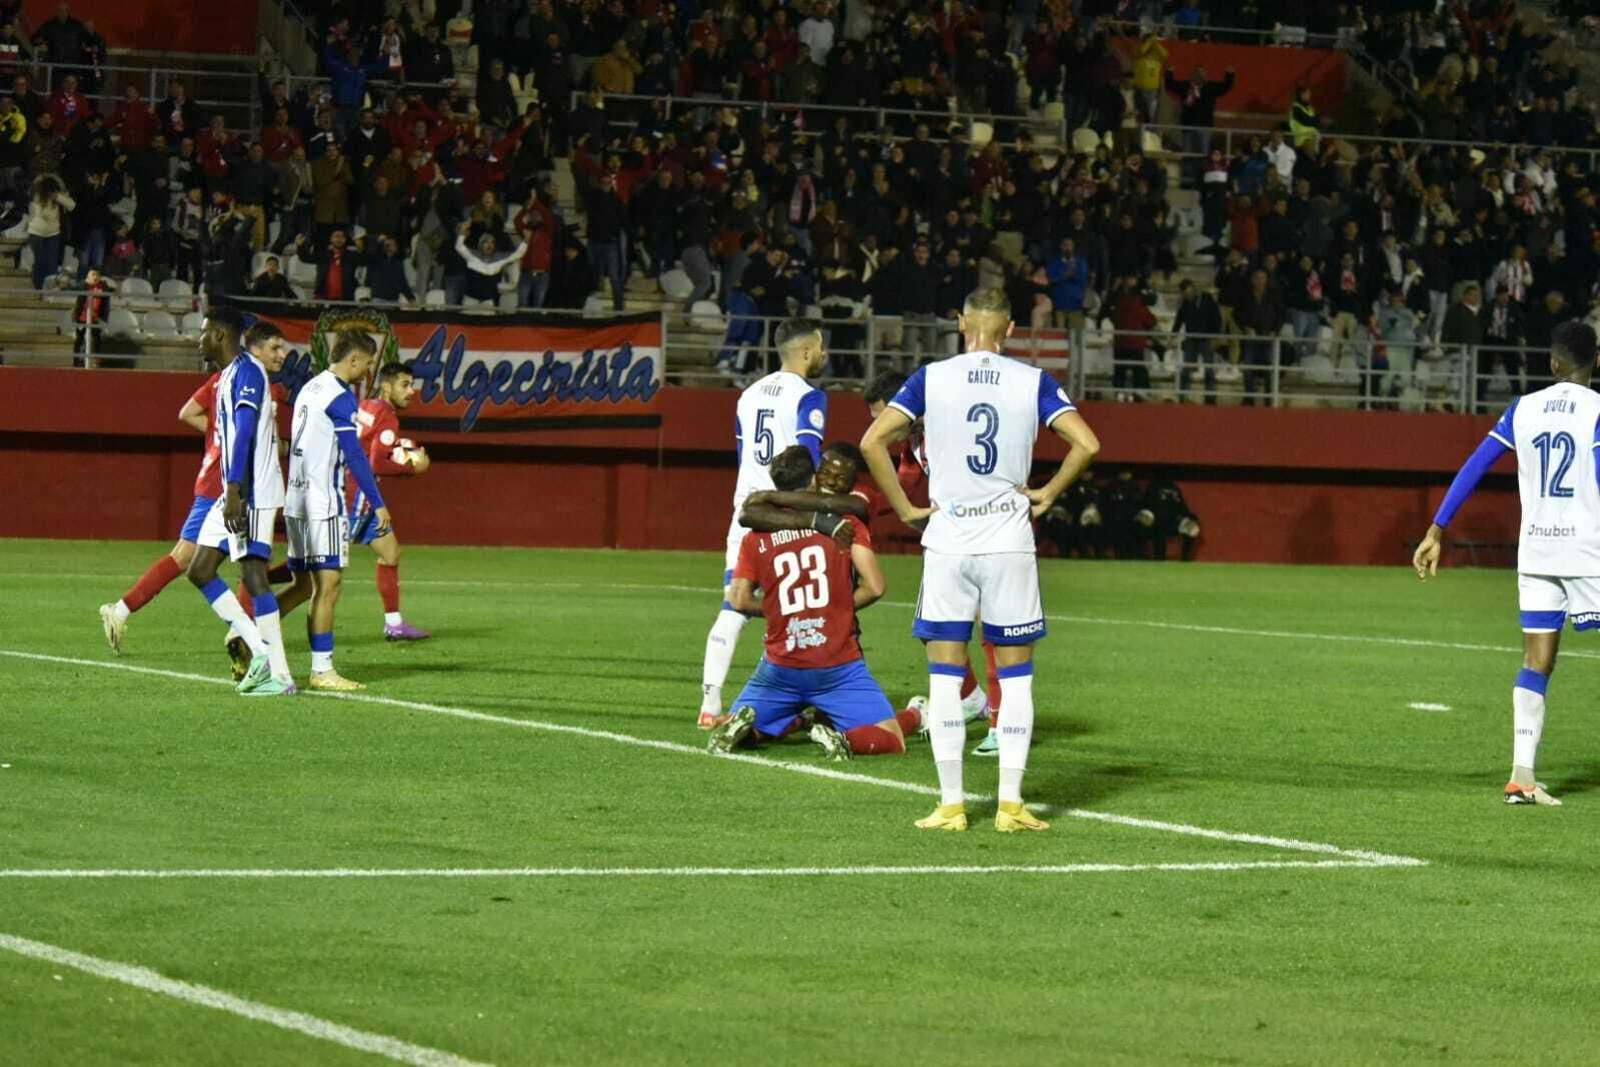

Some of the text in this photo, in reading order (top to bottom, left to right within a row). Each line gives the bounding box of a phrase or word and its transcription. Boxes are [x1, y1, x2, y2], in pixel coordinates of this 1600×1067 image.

[405, 323, 660, 433] Algecirista
[293, 404, 309, 457] 2
[753, 408, 775, 467] 5
[966, 402, 999, 476] 3
[1532, 430, 1576, 498] 12
[953, 499, 1019, 518] Onubat
[773, 544, 829, 616] 23
